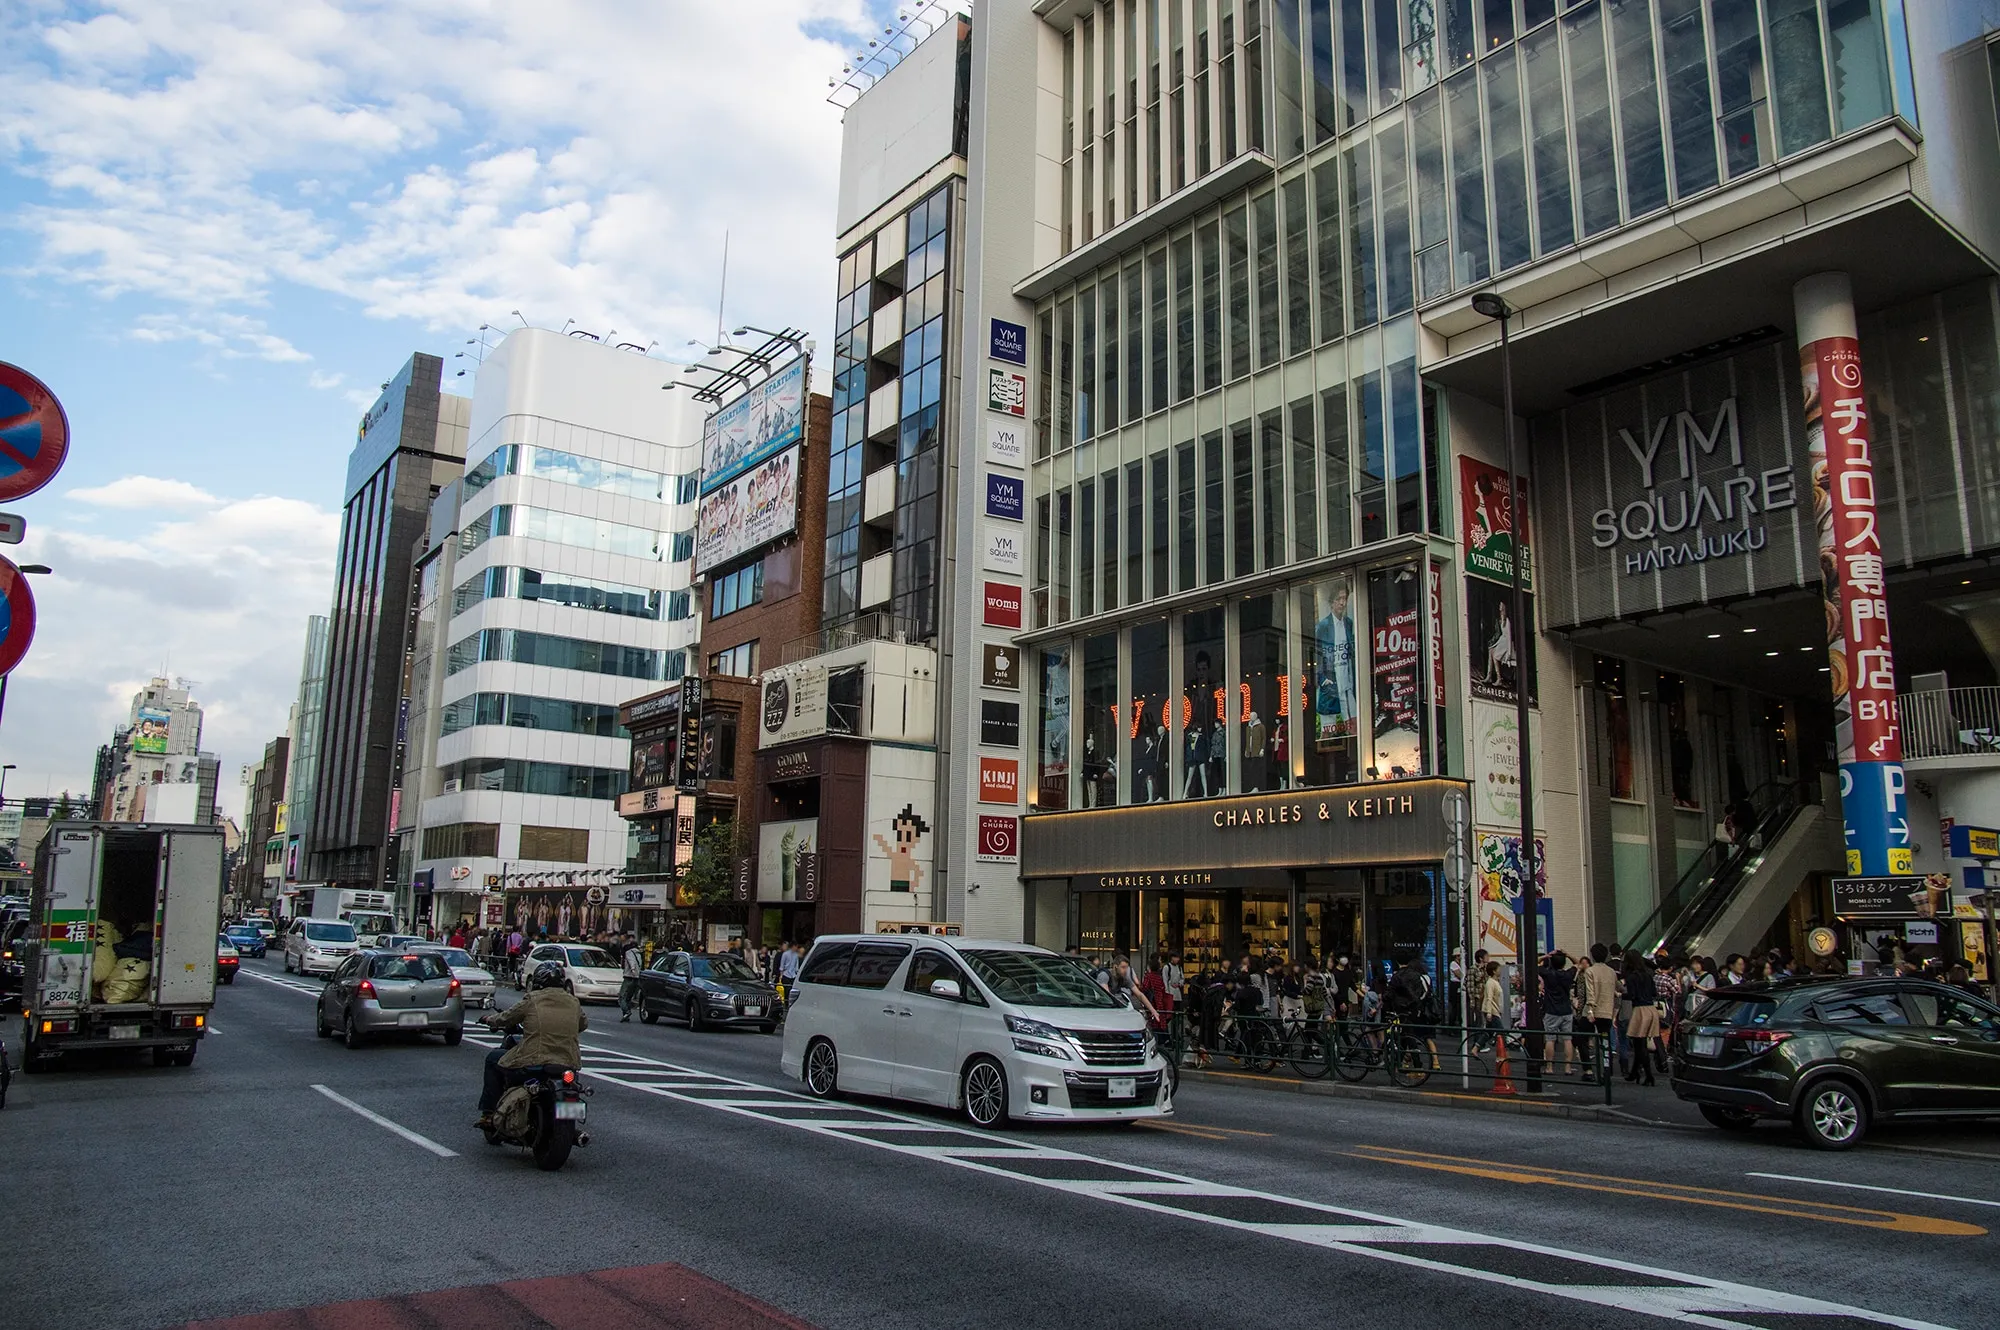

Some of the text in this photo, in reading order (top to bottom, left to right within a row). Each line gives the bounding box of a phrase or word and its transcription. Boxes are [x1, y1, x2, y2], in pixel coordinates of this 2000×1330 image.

[1000, 328, 1017, 342] YM
[994, 338, 1022, 352] SQUARE
[765, 365, 801, 395] STARTLINE
[718, 399, 750, 426] STARTLINE
[997, 431, 1014, 444] YM
[1619, 397, 1743, 489] YM
[992, 441, 1020, 453] SQUARE
[997, 483, 1013, 497] YM
[991, 494, 1019, 507] SQUARE
[1591, 465, 1796, 549] SQUARE
[995, 537, 1012, 550] YM
[1625, 526, 1767, 575] HARAJUKU
[1830, 397, 1895, 690] チュロス専門店
[989, 548, 1018, 560] SQUARE
[1471, 553, 1503, 573] VENIRE
[1376, 629, 1416, 653] 10th
[1397, 686, 1413, 695] TOKYO
[1477, 685, 1506, 698] CHARLES
[1397, 712, 1412, 720] KOBE
[778, 752, 807, 767] GODIVA
[983, 770, 1015, 785] KINJI
[996, 783, 1013, 791] clothing
[1883, 765, 1906, 813] P
[1213, 795, 1414, 828] CHARLES & KEITH
[679, 817, 692, 844] 和民
[982, 822, 1014, 830] CHURRO
[1896, 860, 1912, 871] OK
[740, 858, 748, 900] GODIVA
[806, 855, 815, 900] GODIVA
[1100, 874, 1212, 887] CHARLES & KEITH
[66, 920, 87, 943] 福
[1491, 914, 1516, 945] KINJI
[50, 991, 81, 1001] 88749
